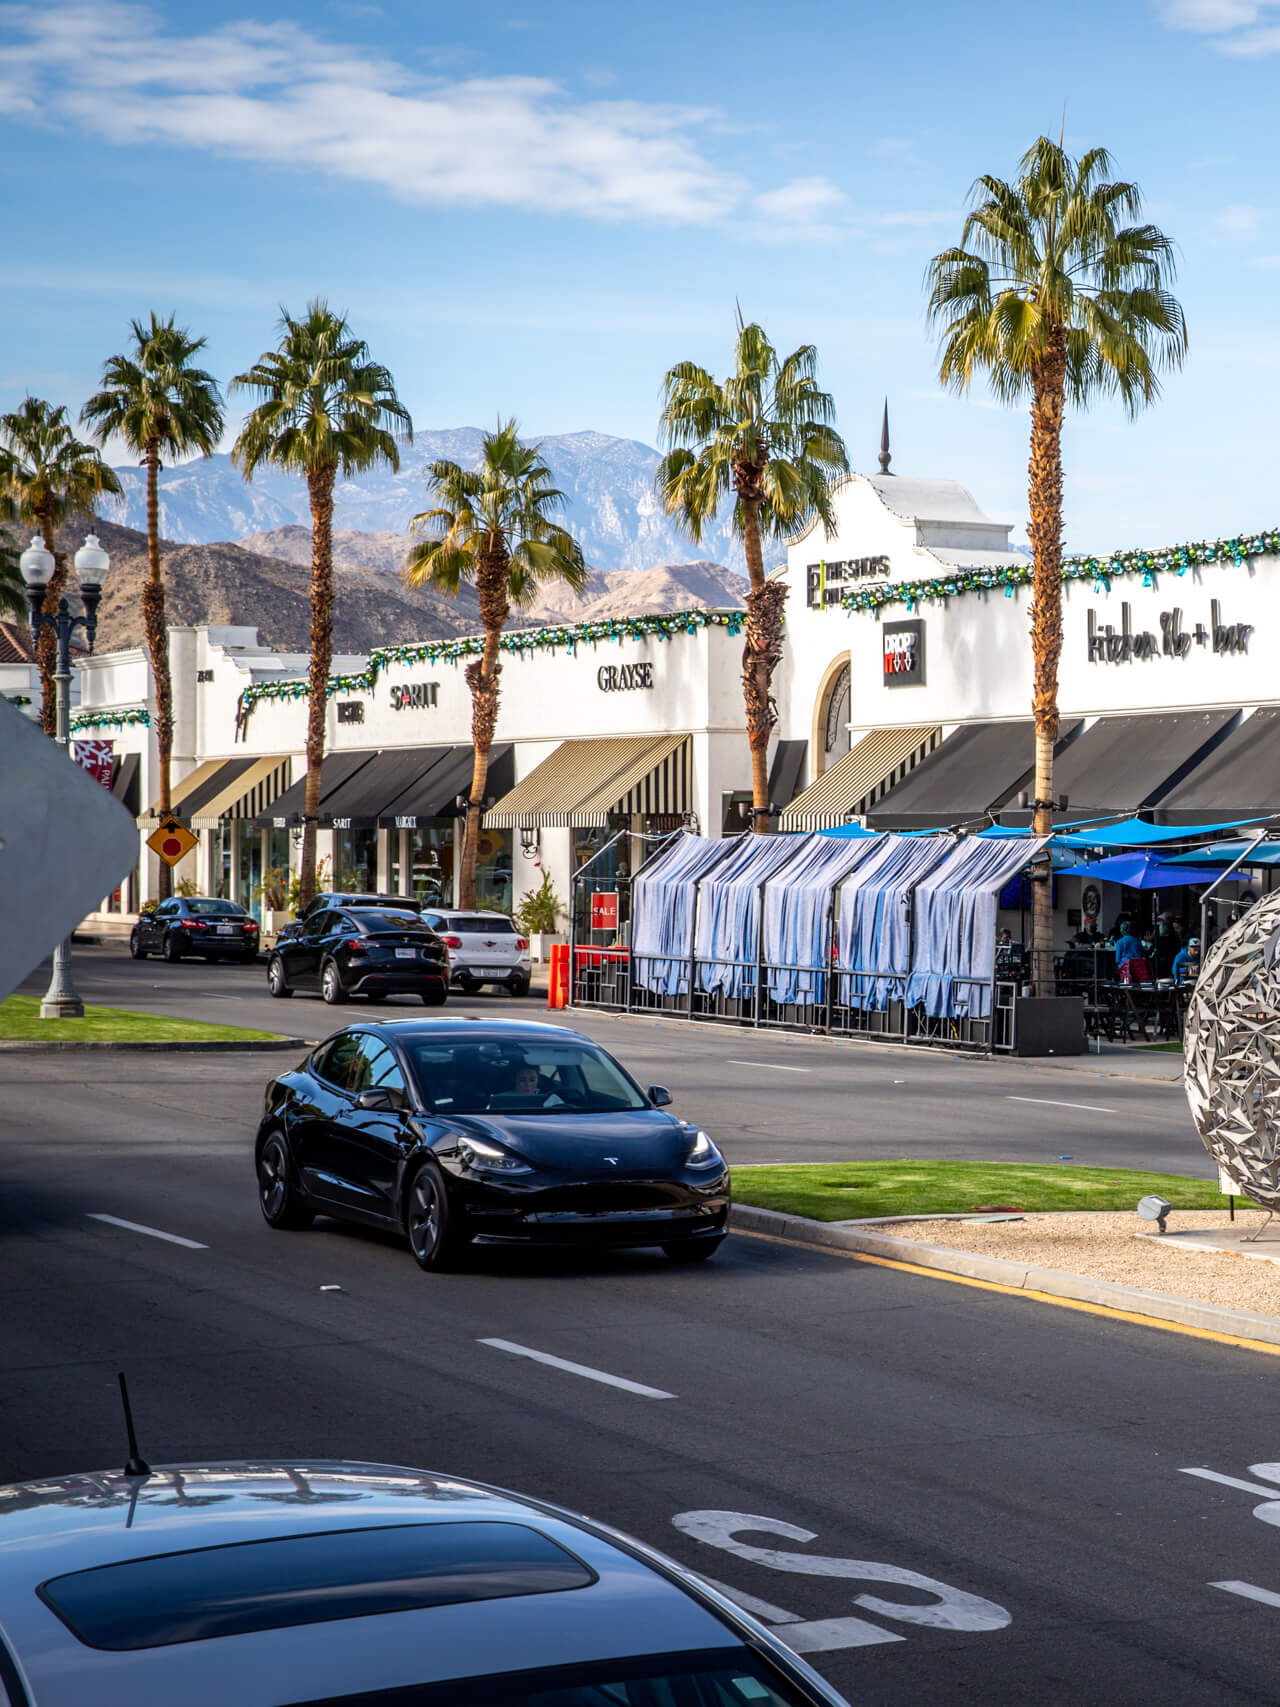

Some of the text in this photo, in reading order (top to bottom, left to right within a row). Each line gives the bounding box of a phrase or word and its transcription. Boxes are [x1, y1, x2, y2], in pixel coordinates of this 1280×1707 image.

[848, 555, 890, 577] SHOPS
[1210, 598, 1254, 656] bar
[884, 632, 915, 655] DROP
[884, 652, 896, 673] IT
[597, 661, 654, 693] GRAYSE
[390, 681, 441, 711] SARIT
[332, 817, 352, 829] SARIT
[592, 905, 617, 917] SALE
